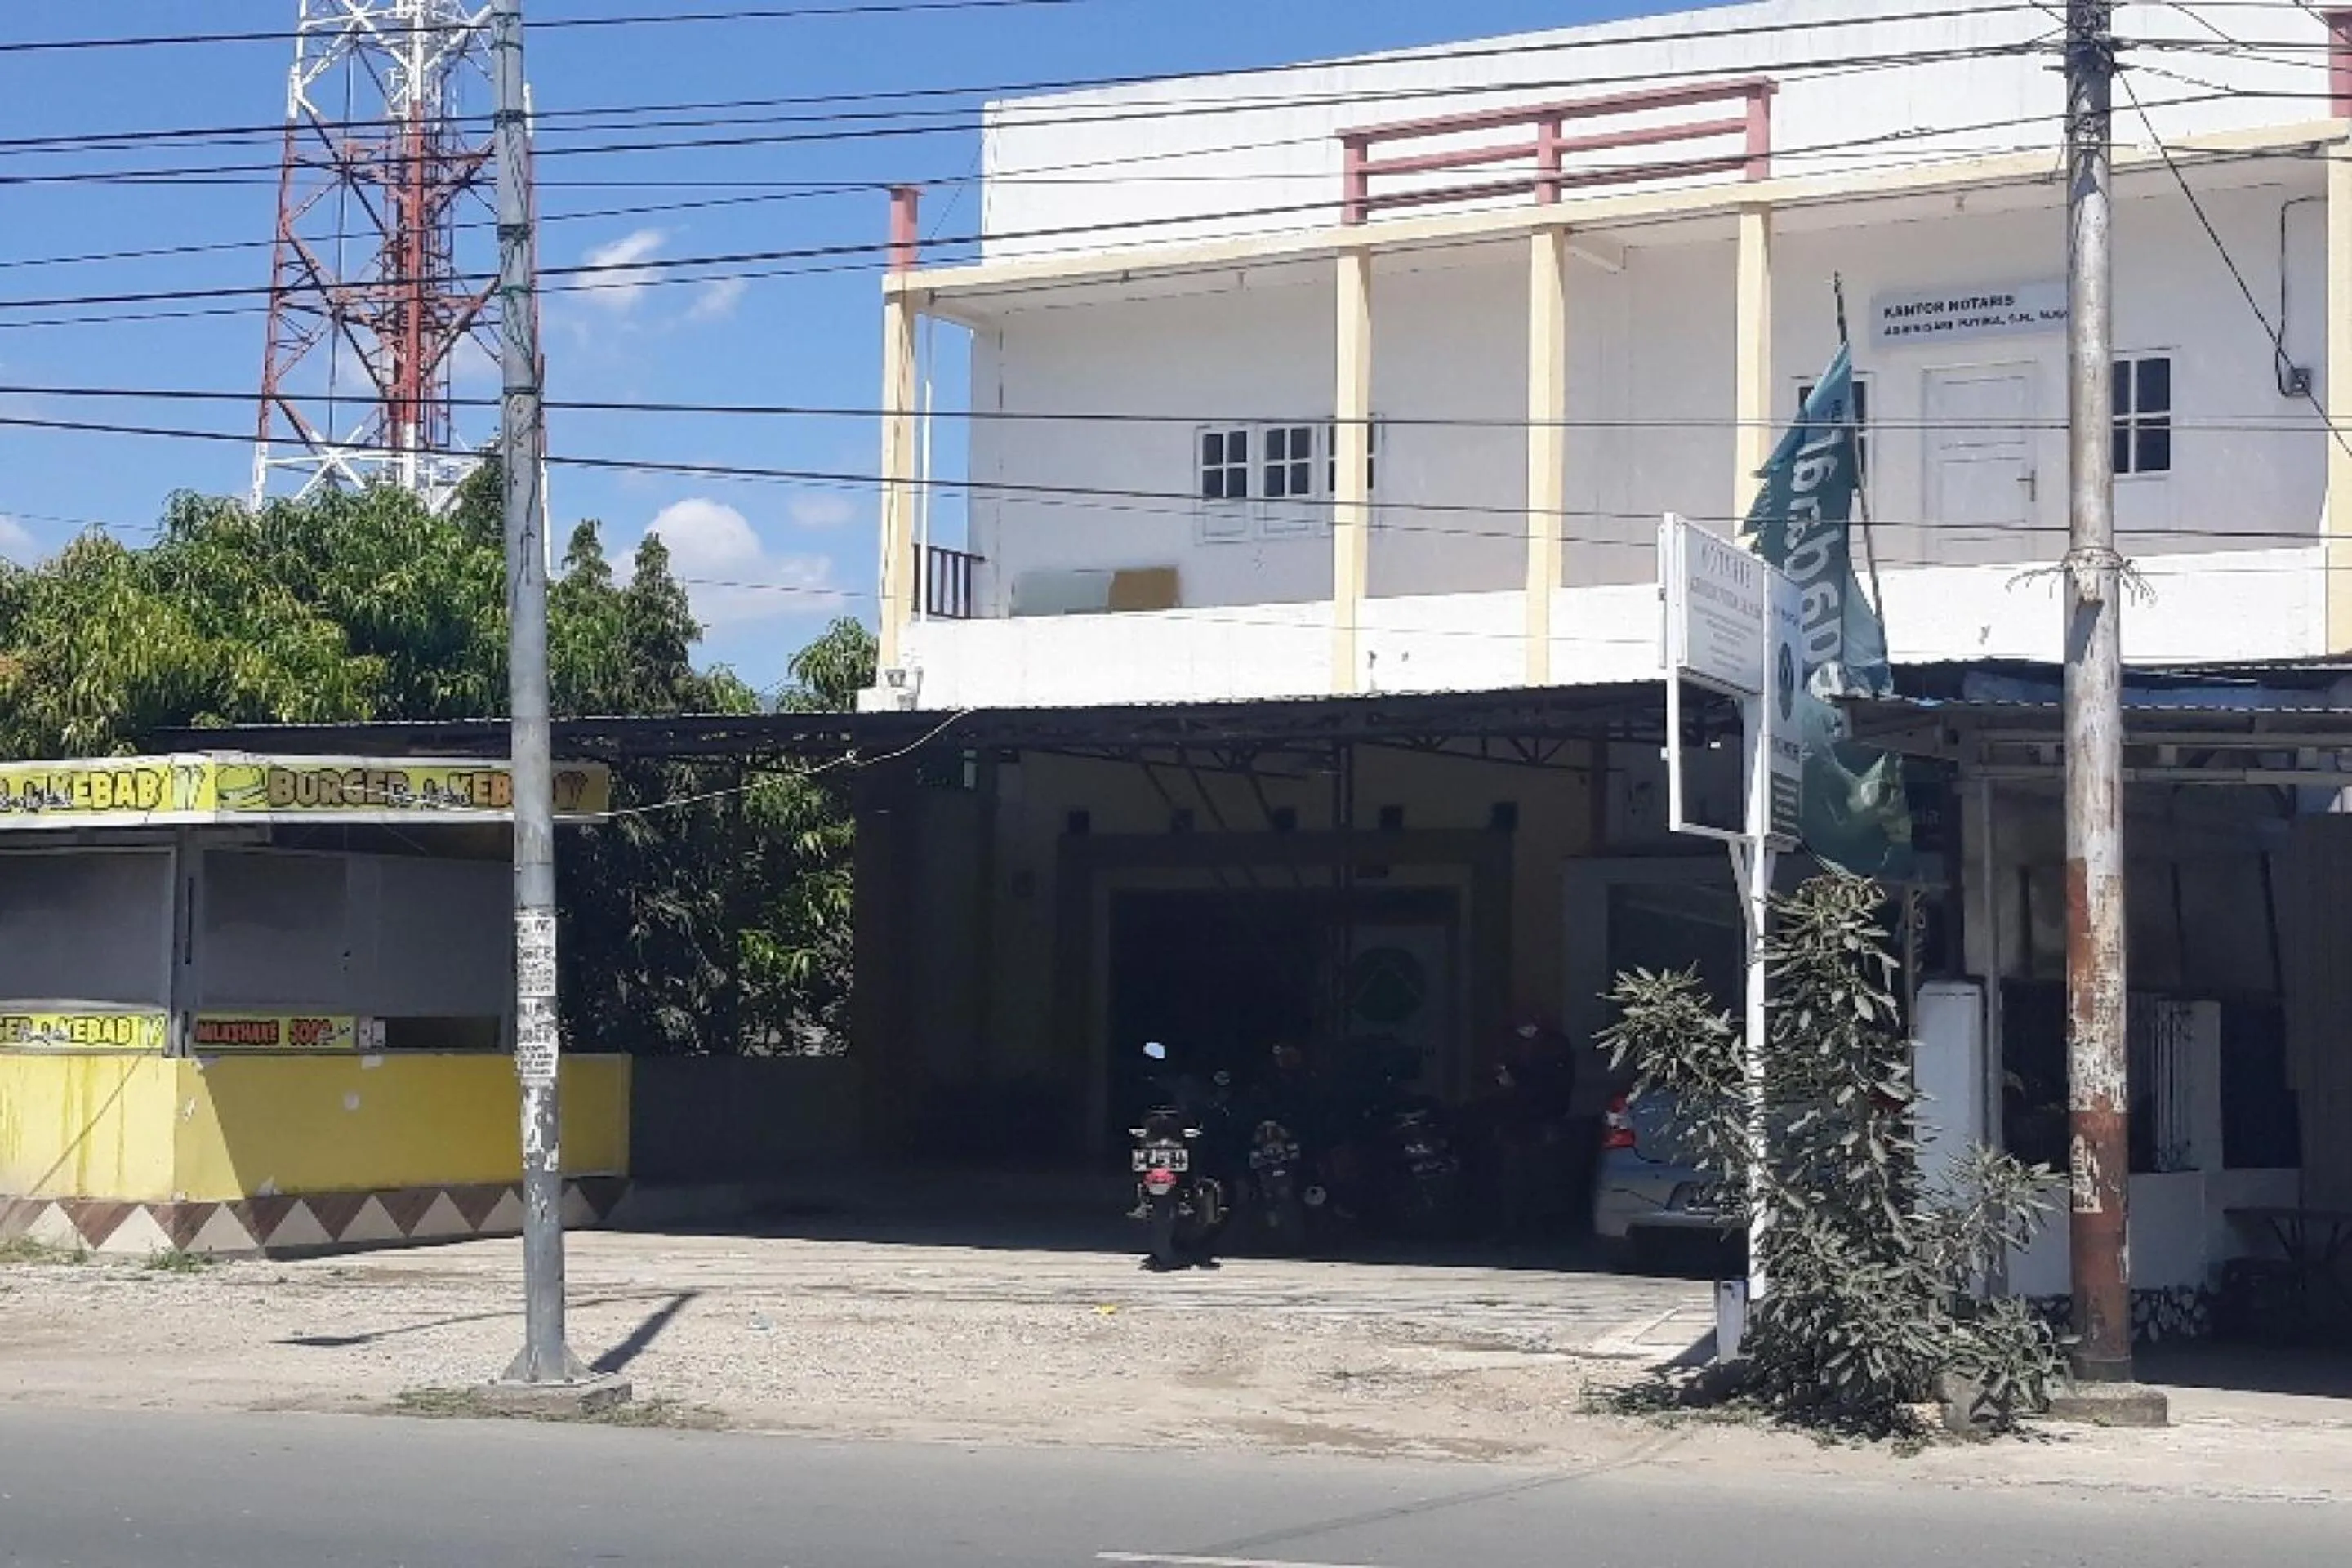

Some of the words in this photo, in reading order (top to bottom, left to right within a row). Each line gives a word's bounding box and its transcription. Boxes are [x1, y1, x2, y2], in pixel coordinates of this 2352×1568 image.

[1884, 301, 1944, 319] KANTOR
[1949, 294, 2016, 312] NOTARIS
[47, 768, 159, 811] KEBAB
[269, 768, 409, 808] BURGER
[447, 770, 514, 807] KEB
